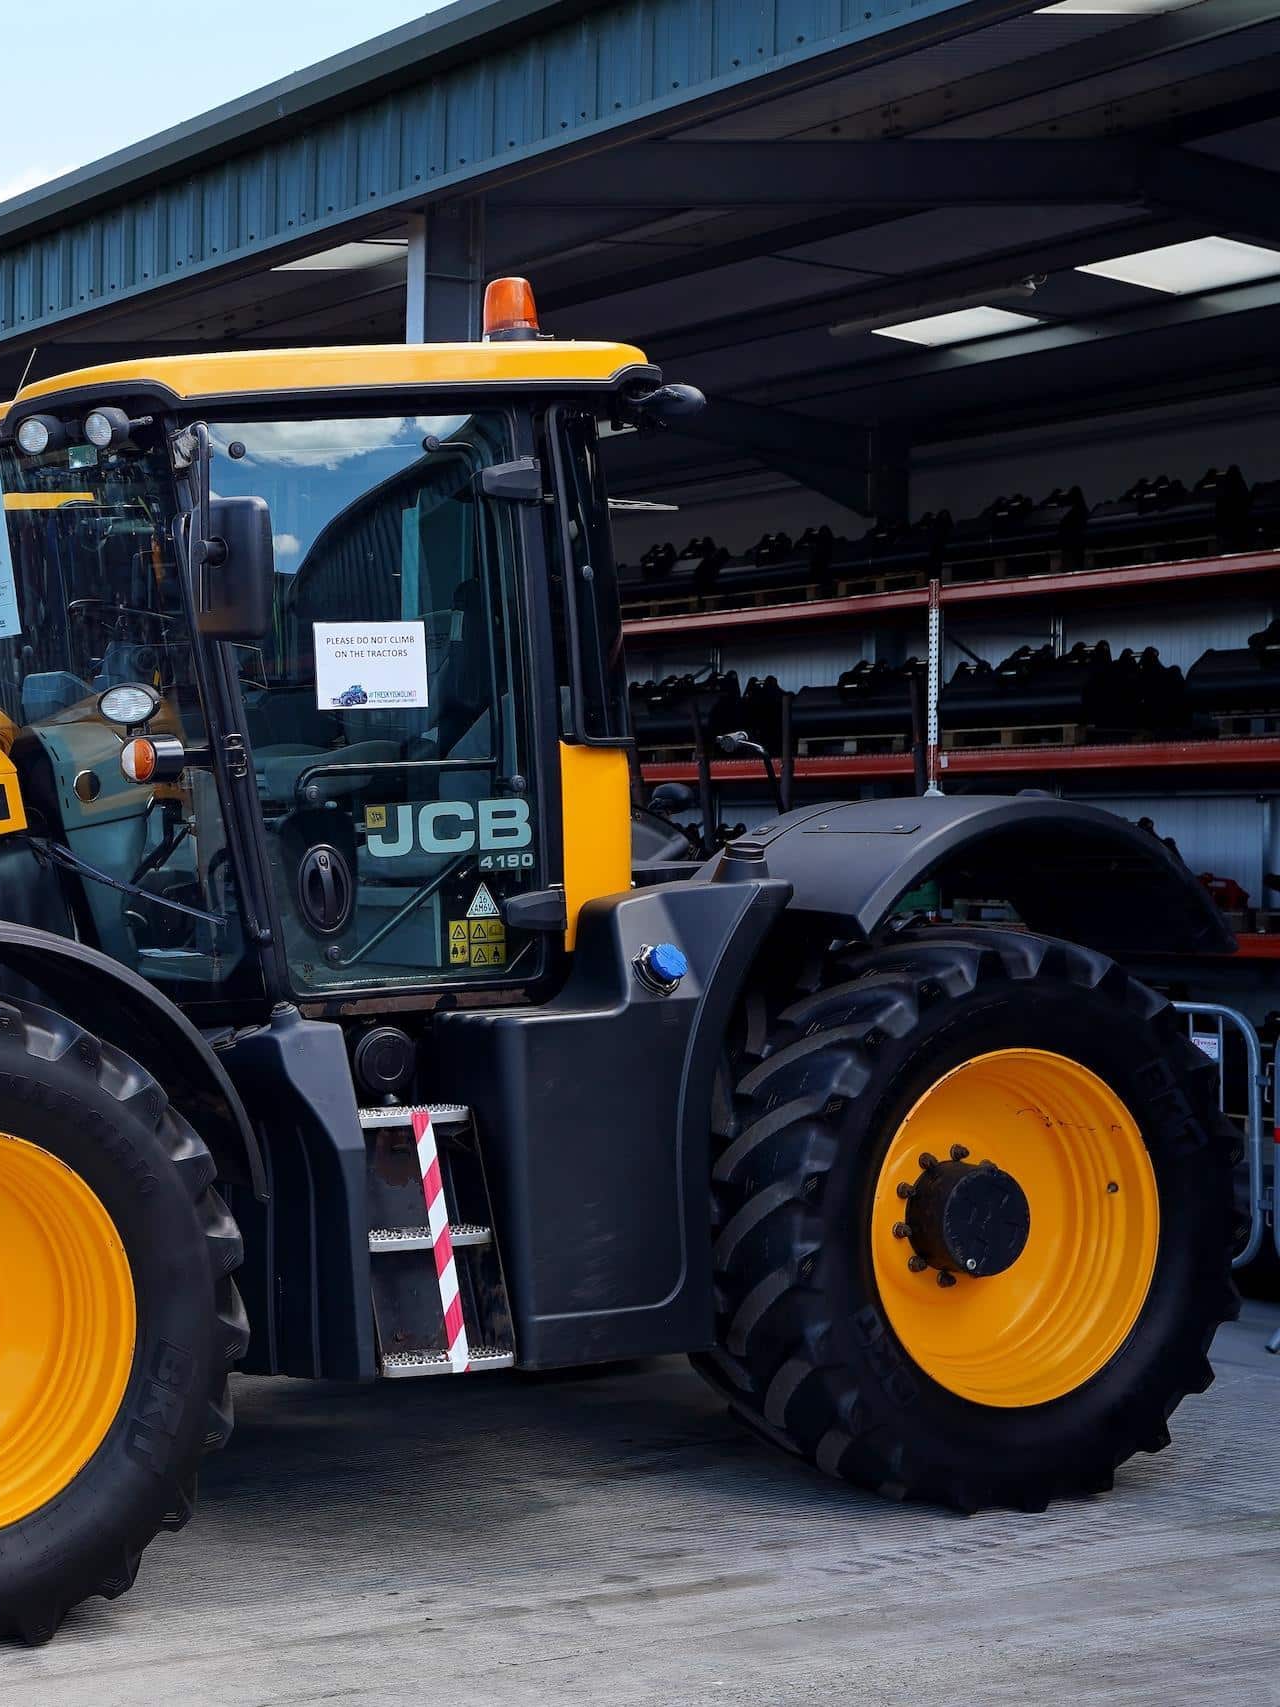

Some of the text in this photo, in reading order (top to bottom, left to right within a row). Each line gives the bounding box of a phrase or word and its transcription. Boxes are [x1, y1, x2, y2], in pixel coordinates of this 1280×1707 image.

[326, 635, 415, 645] PLEASE DO NOT CLIMB
[334, 649, 408, 659] ON THE TRACTORS
[367, 798, 533, 858] JCB
[480, 853, 534, 869] 4190
